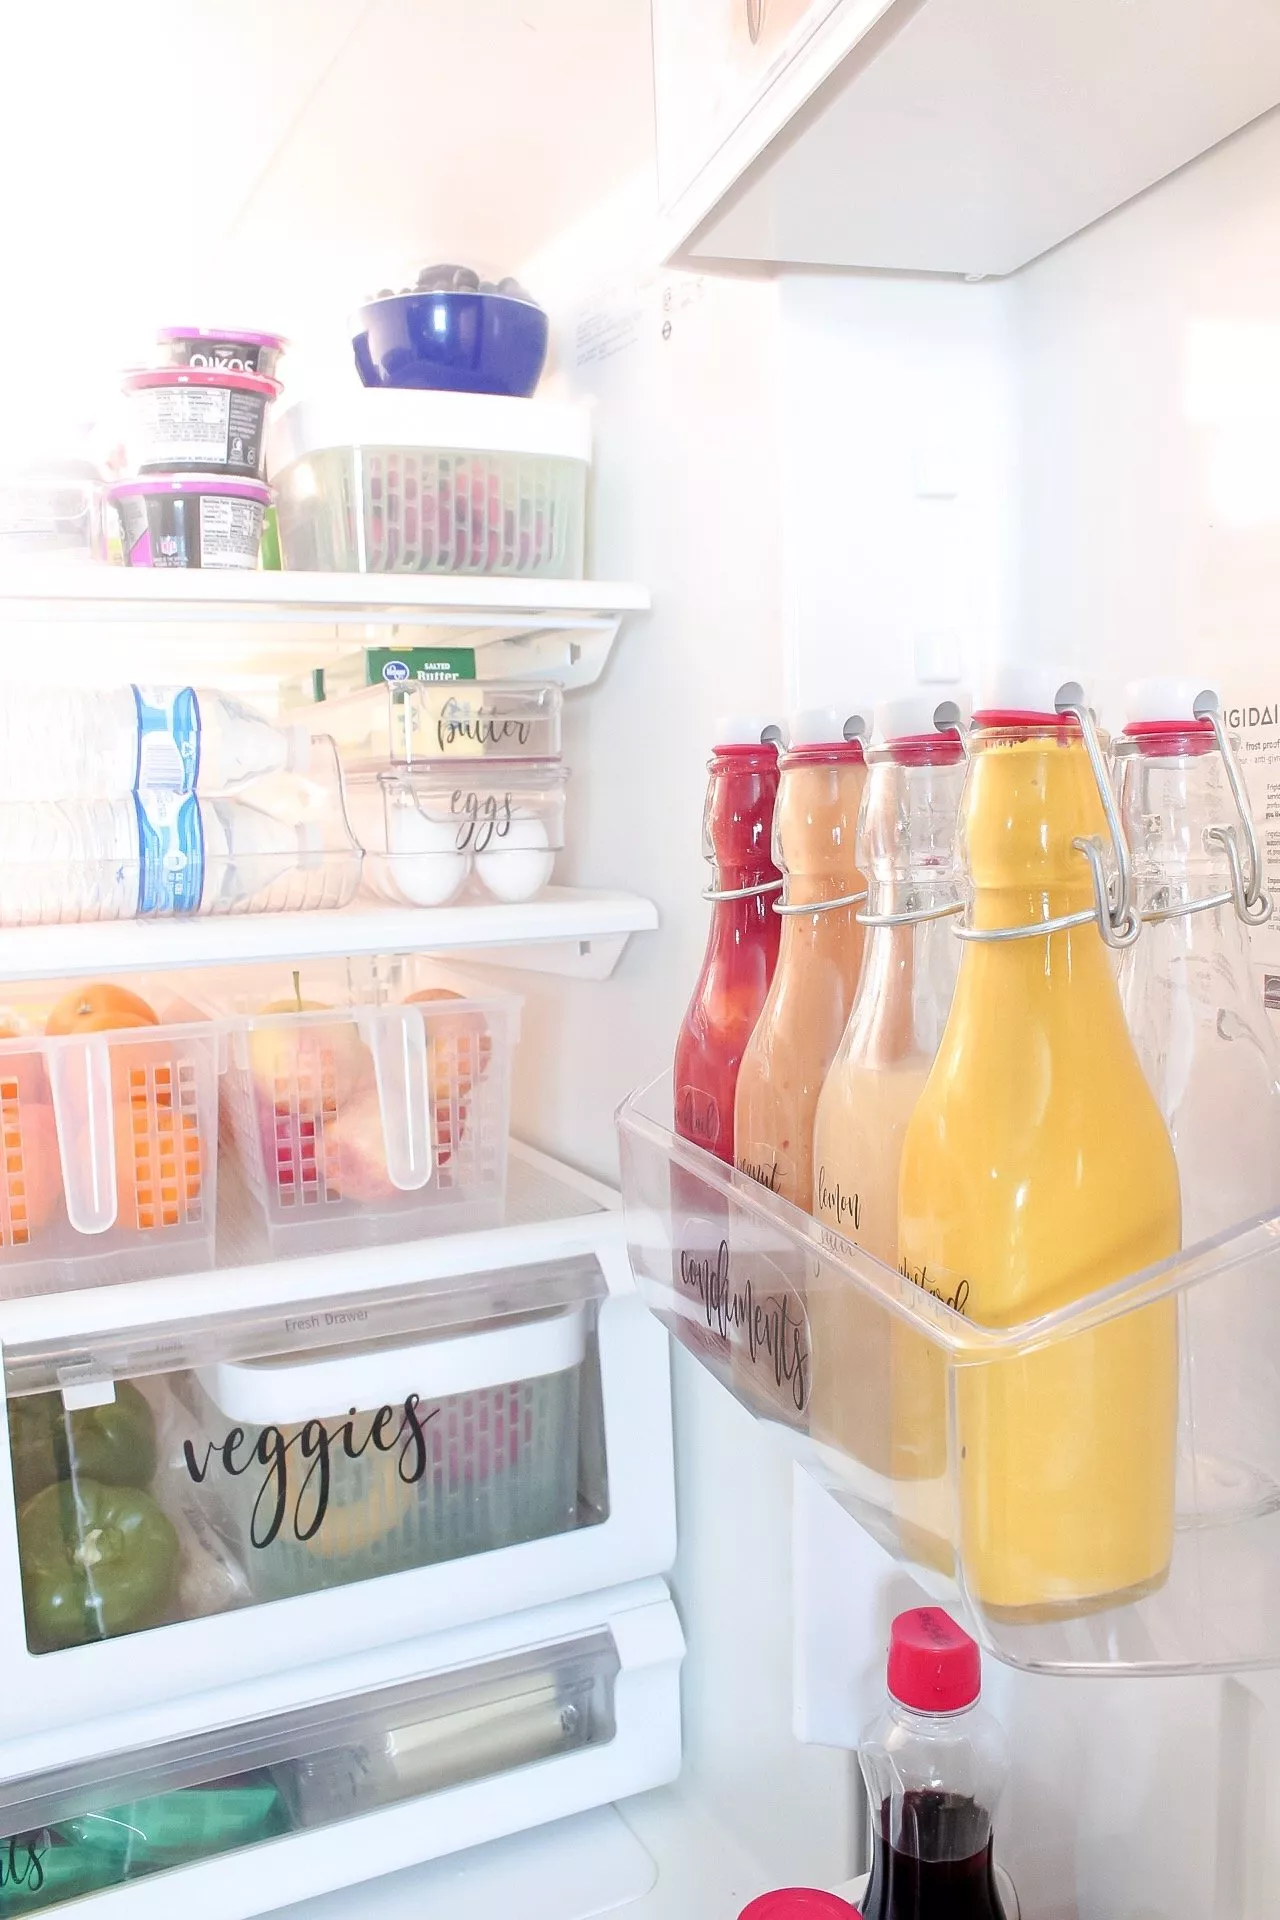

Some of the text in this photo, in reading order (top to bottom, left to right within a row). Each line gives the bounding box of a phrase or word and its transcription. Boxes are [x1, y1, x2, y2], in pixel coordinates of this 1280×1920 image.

[189, 353, 254, 373] OIKOS
[416, 670, 460, 681] Butter
[424, 662, 451, 670] SALTED
[437, 696, 531, 752] butter
[450, 788, 522, 853] eggs
[818, 1164, 862, 1230] lemon
[284, 1310, 370, 1333] Fresh Drawer
[680, 1237, 810, 1412] condiments
[183, 1392, 441, 1549] veggies
